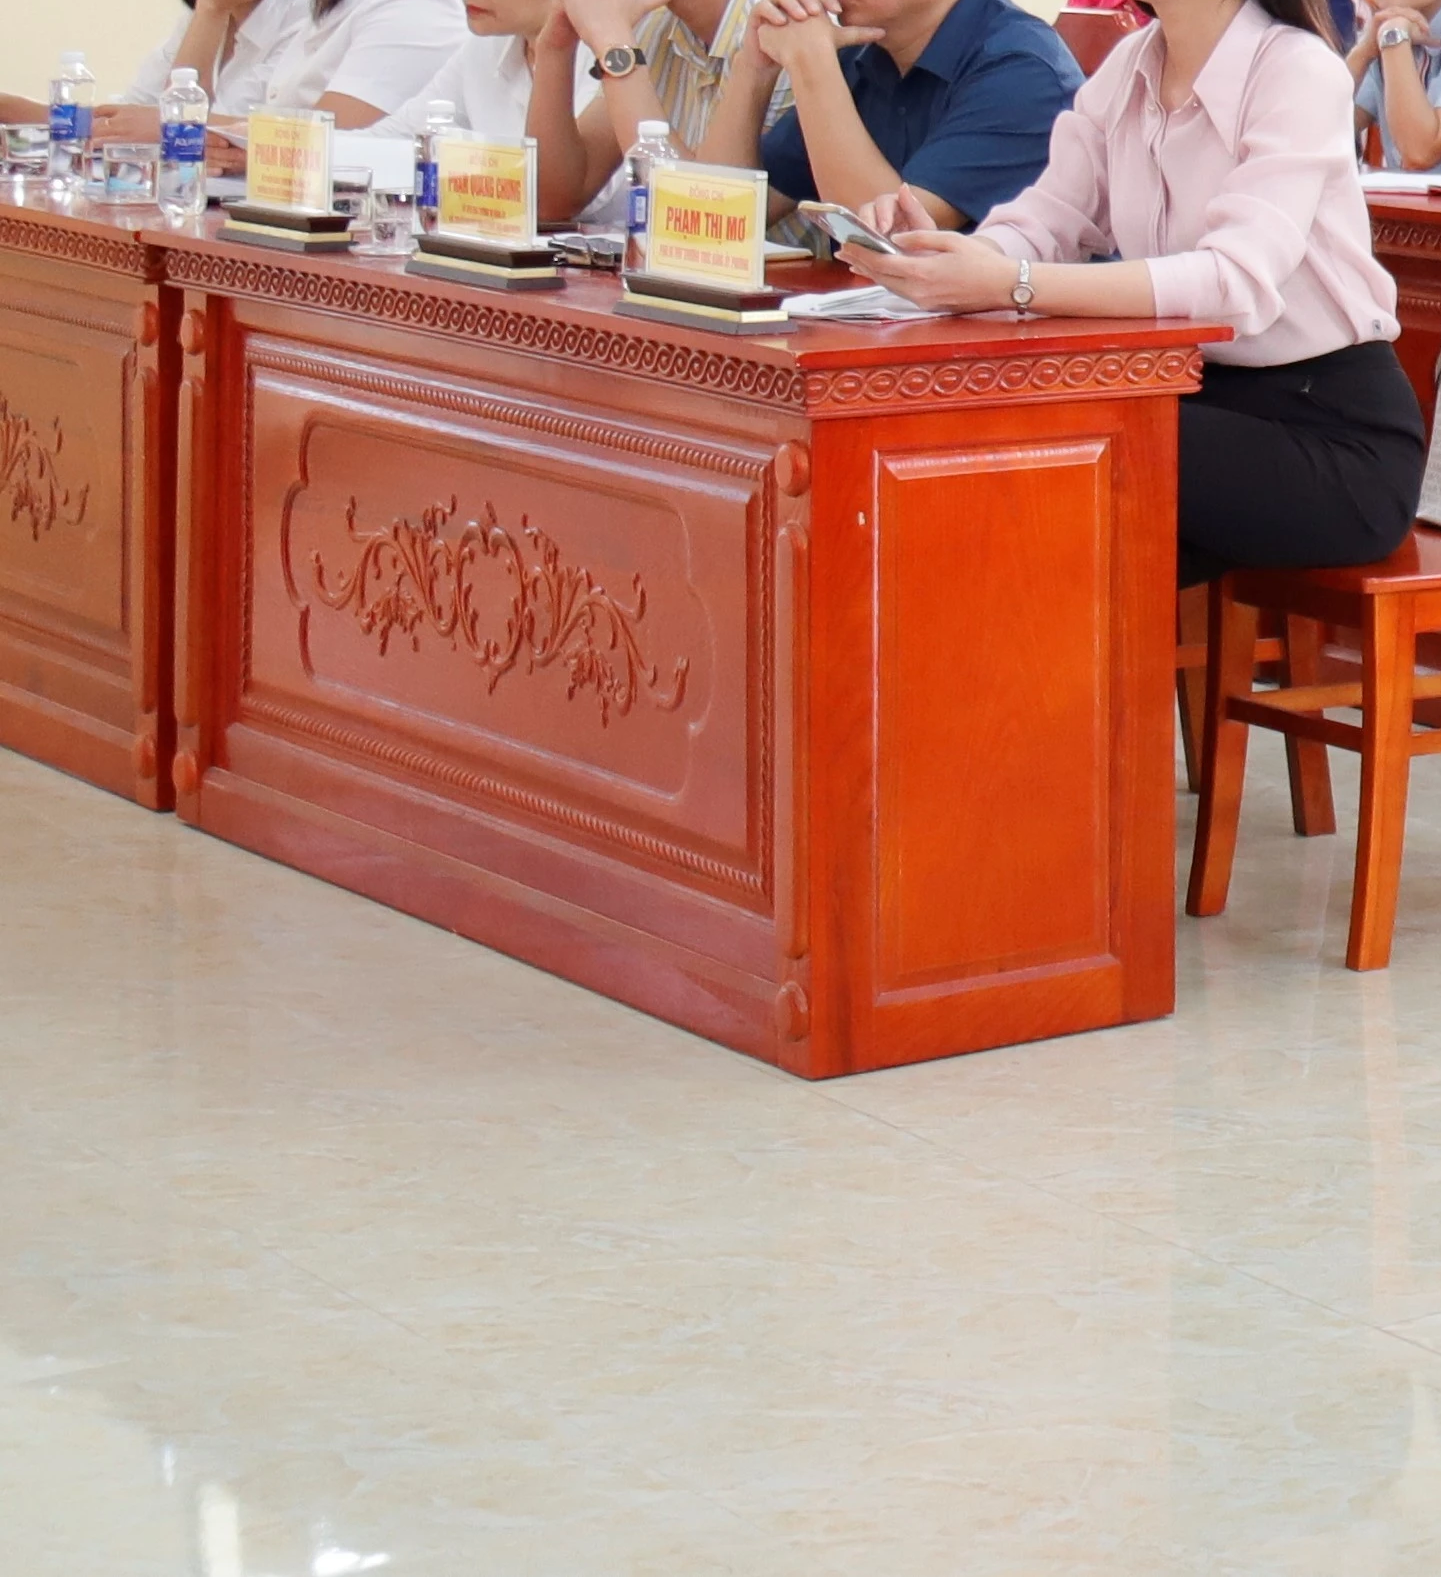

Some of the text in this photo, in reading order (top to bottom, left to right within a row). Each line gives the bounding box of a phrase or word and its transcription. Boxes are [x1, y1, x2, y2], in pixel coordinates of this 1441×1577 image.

[666, 206, 746, 245] PHẠM THỊ MƠ
